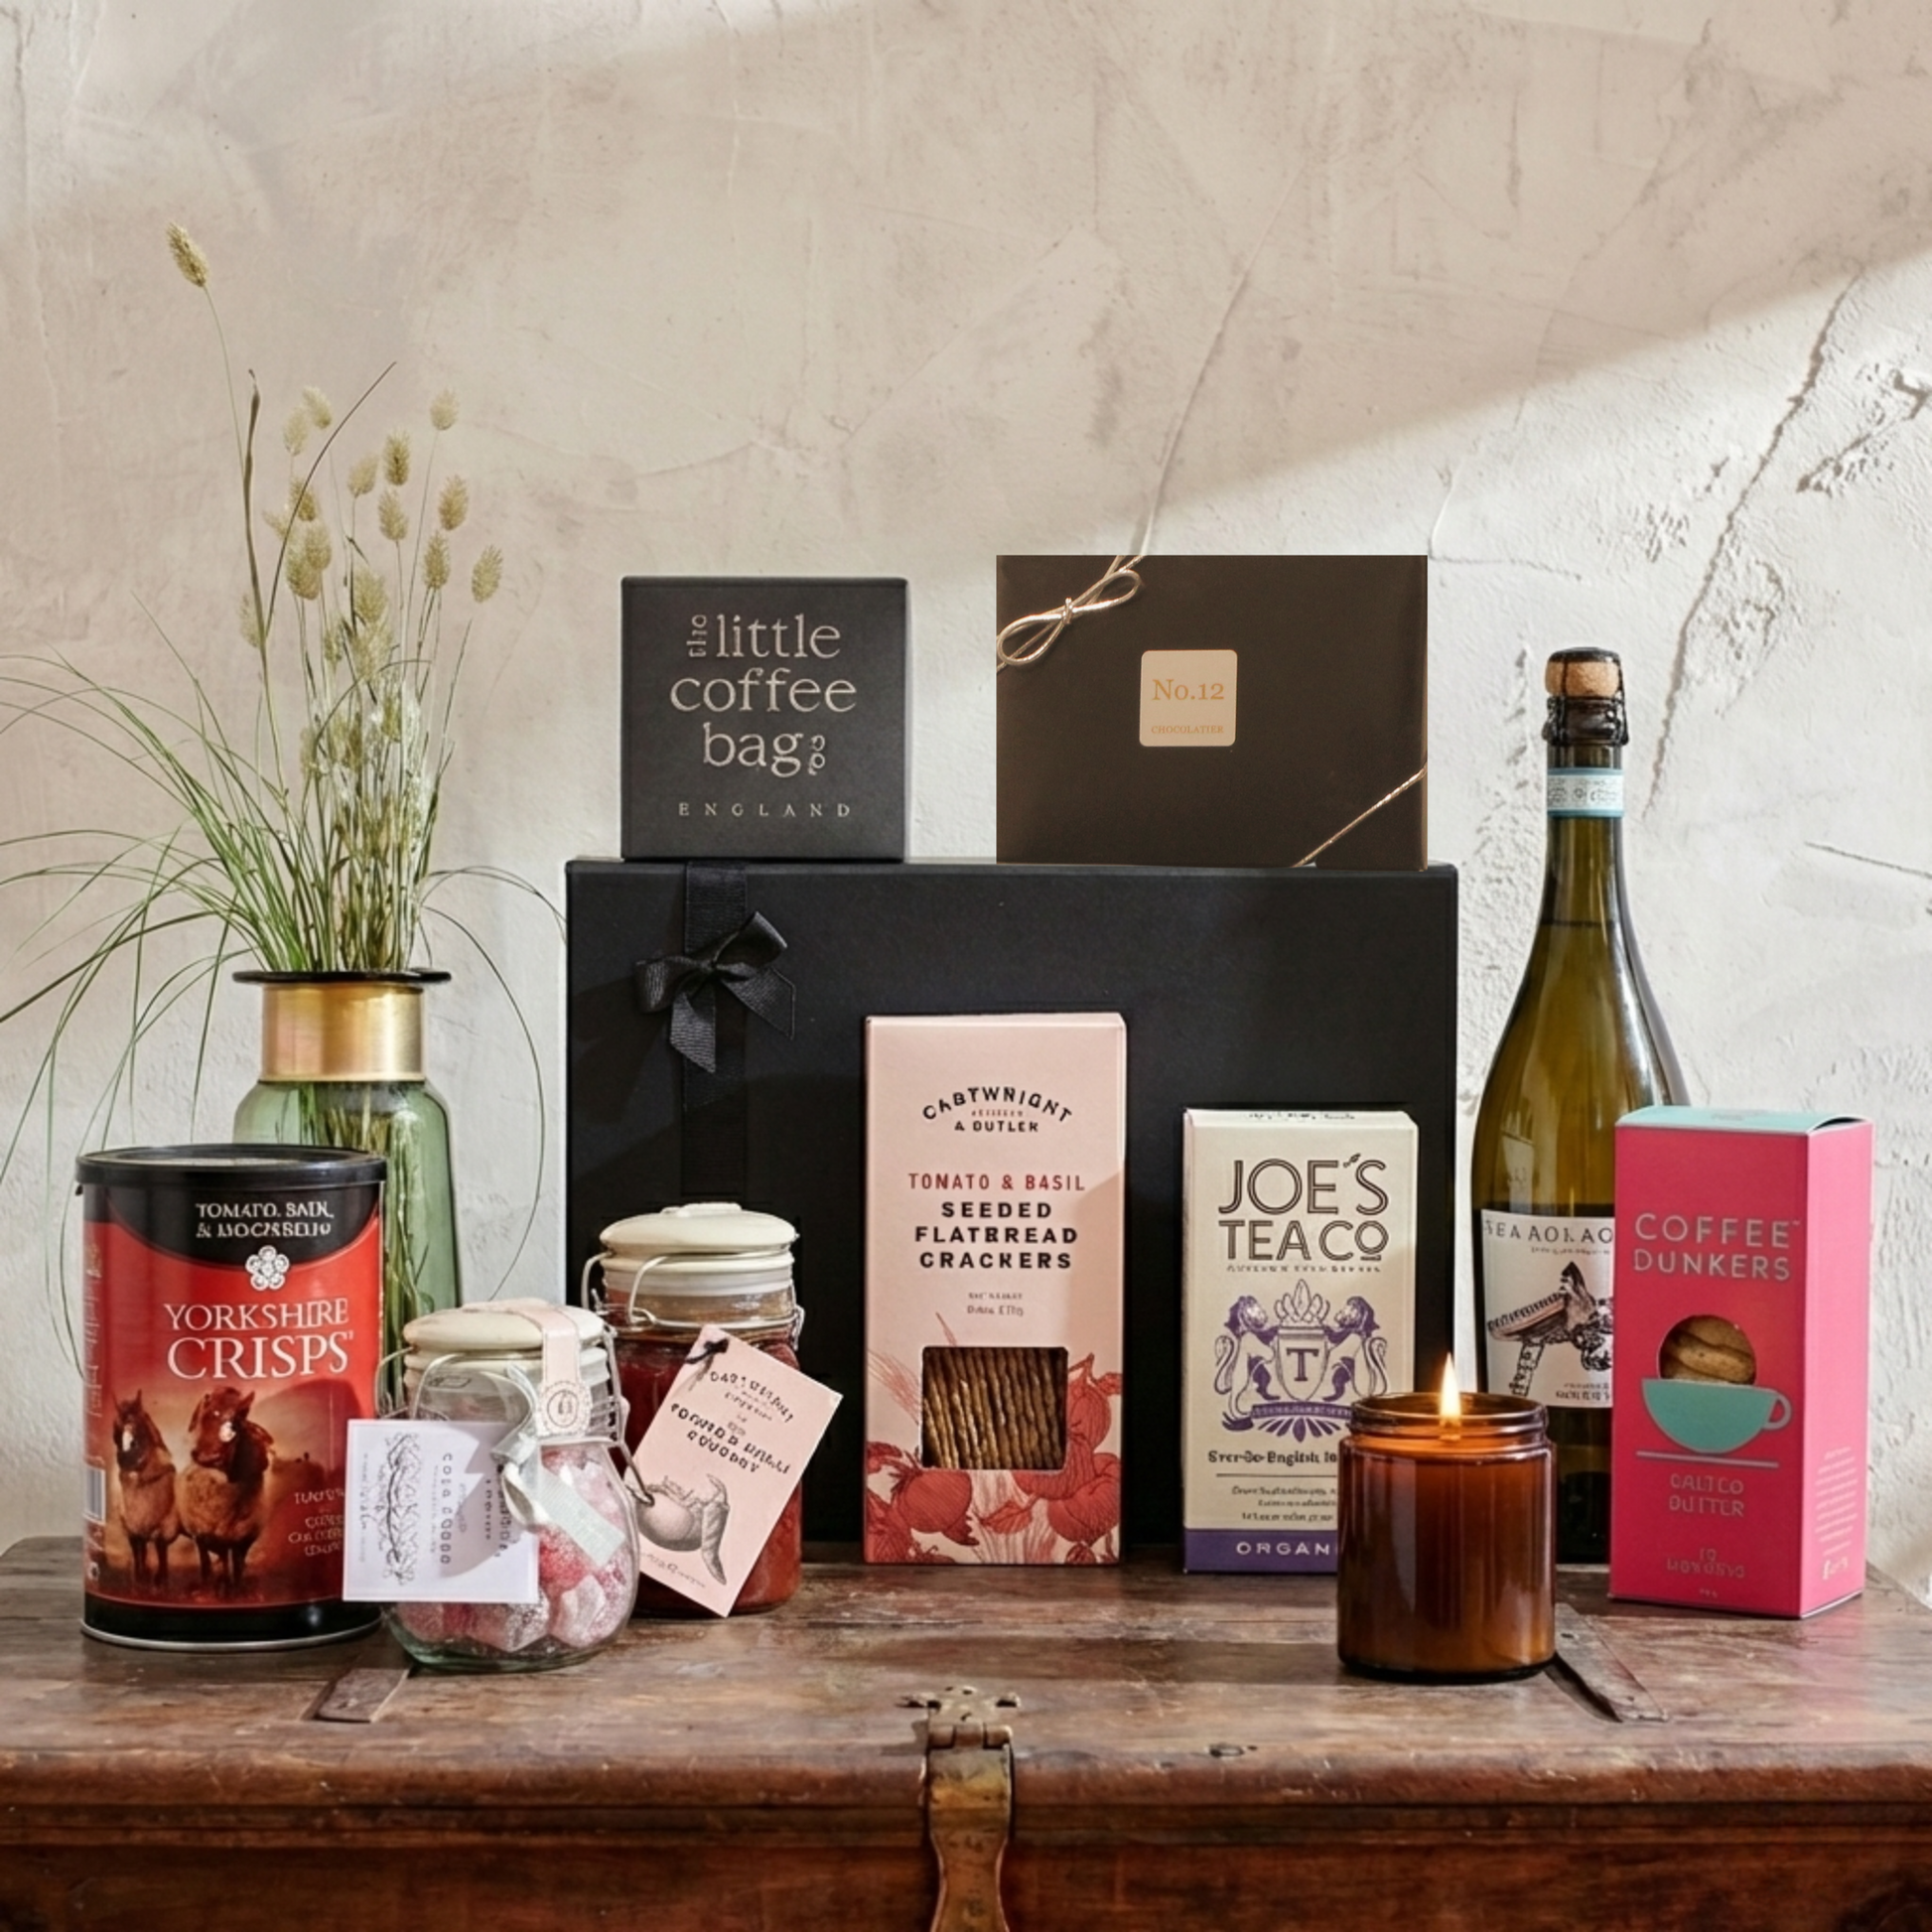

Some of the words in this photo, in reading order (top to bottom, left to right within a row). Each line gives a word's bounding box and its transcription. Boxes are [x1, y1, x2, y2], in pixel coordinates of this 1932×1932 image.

[716, 614, 841, 658] little
[669, 667, 857, 712] coffee
[1152, 678, 1225, 701] No.12
[1151, 725, 1224, 735] CHOCOLATIER
[703, 722, 804, 777] bag
[678, 802, 850, 817] ENGLAND
[1002, 1174, 1014, 1190] &
[1026, 1174, 1085, 1191] BASIL
[941, 1201, 1051, 1218] SEEDED
[914, 1226, 1078, 1244] FLATBREAD
[1635, 1213, 1790, 1248] COFFEE
[919, 1252, 1071, 1269] CRACKERS
[1633, 1249, 1790, 1281] DUNKERS
[164, 1298, 349, 1331] YORKSHIRE
[1286, 1347, 1319, 1382] T
[1236, 1542, 1336, 1556] ORGAN
